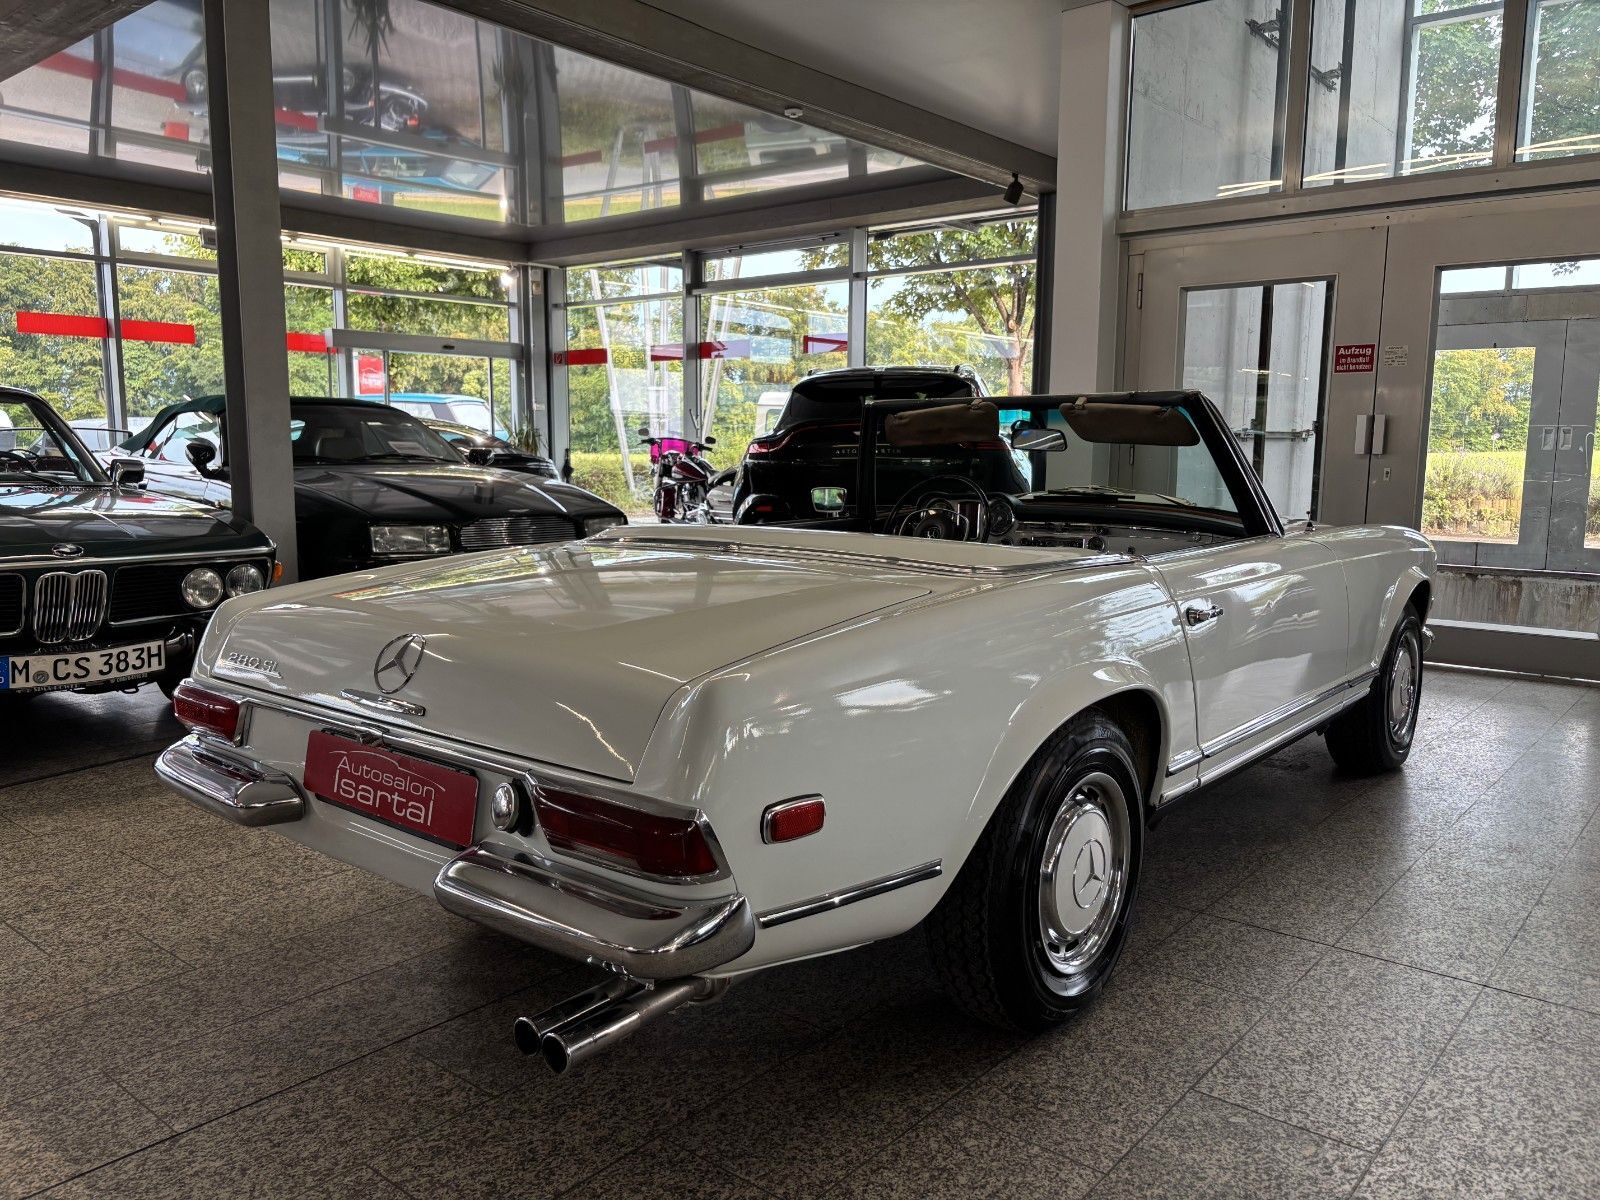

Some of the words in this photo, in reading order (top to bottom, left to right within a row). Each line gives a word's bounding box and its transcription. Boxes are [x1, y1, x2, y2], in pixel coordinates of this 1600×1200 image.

[1338, 347, 1372, 356] Aufzug
[11, 659, 30, 684] M
[53, 657, 91, 681] CS
[98, 645, 163, 675] 383H
[333, 769, 434, 827] Isartal
[337, 756, 435, 800] Autosalon
